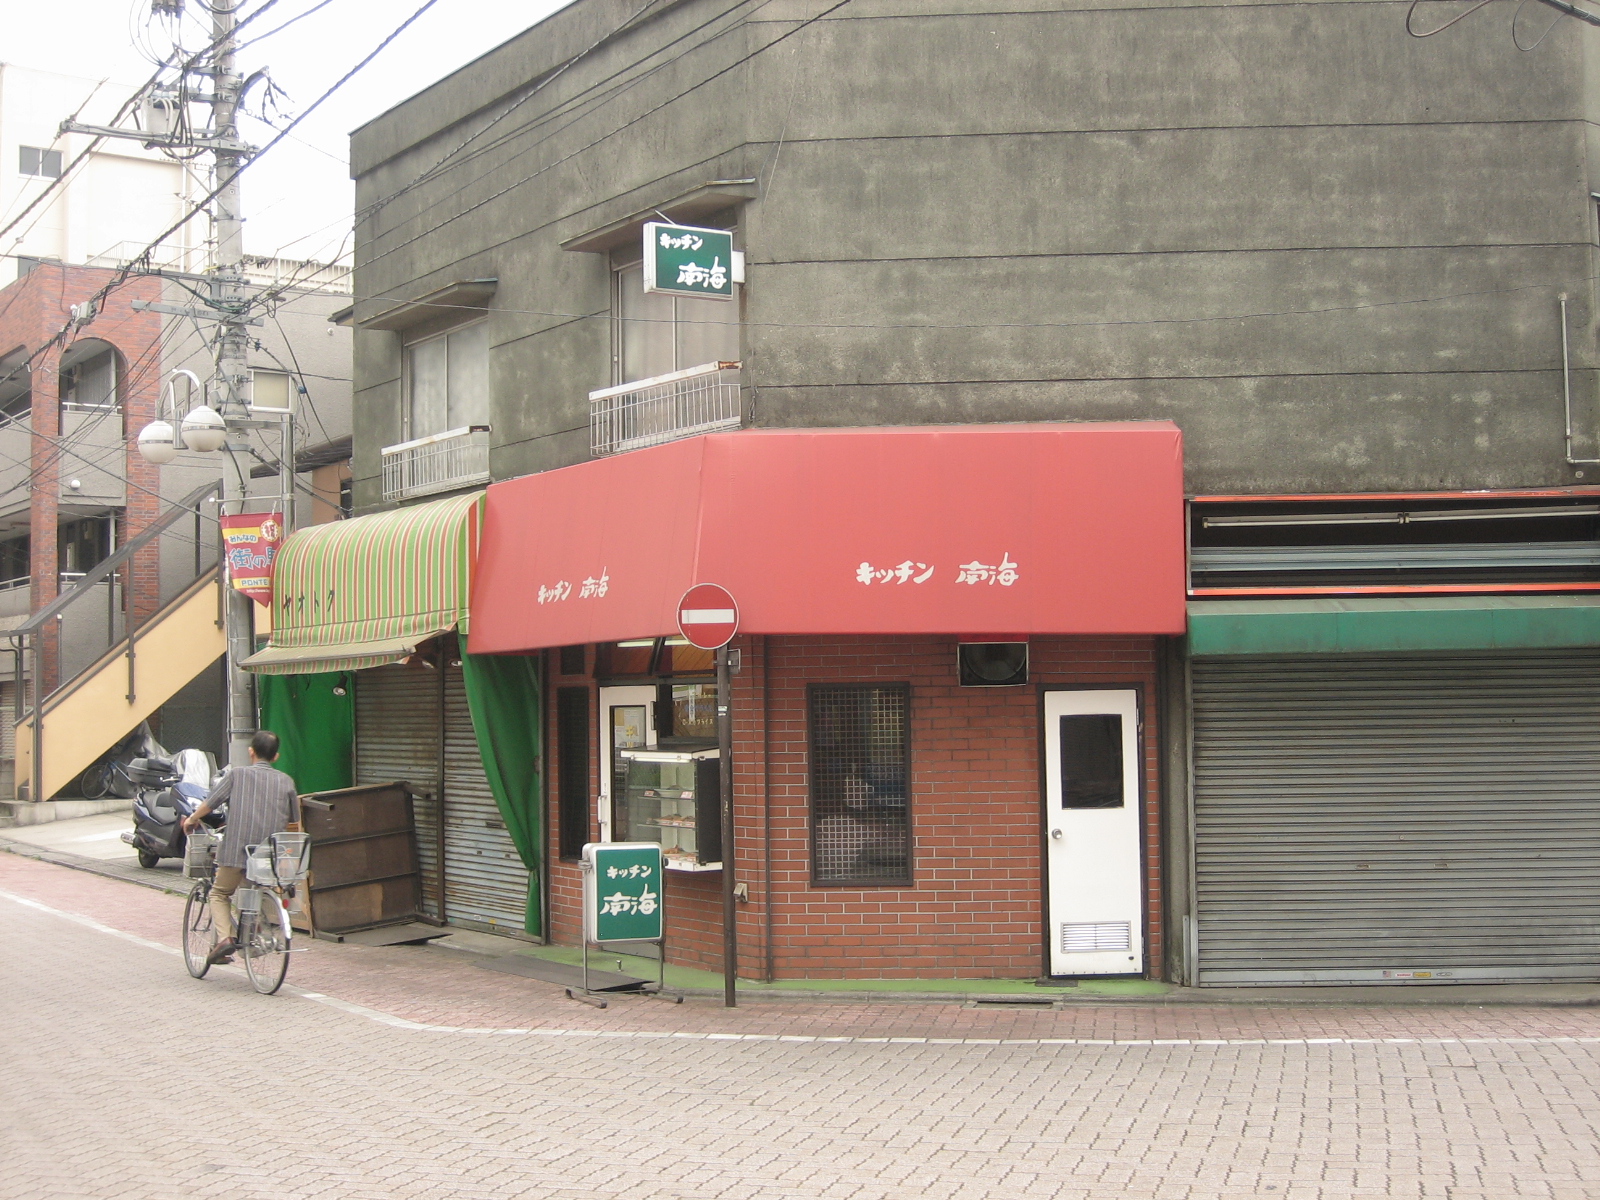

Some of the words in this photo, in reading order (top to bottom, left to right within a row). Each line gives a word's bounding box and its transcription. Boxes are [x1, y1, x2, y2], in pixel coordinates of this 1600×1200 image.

[660, 232, 703, 251] キッチン
[676, 255, 728, 290] 南海
[229, 534, 258, 543] みんなの
[856, 559, 935, 586] キッチン
[954, 551, 1019, 586] 南海
[241, 578, 269, 587] PONTE
[537, 579, 572, 605] キッチン
[578, 565, 610, 599] 南海
[606, 863, 652, 880] キッチン
[599, 883, 659, 917] 南海
